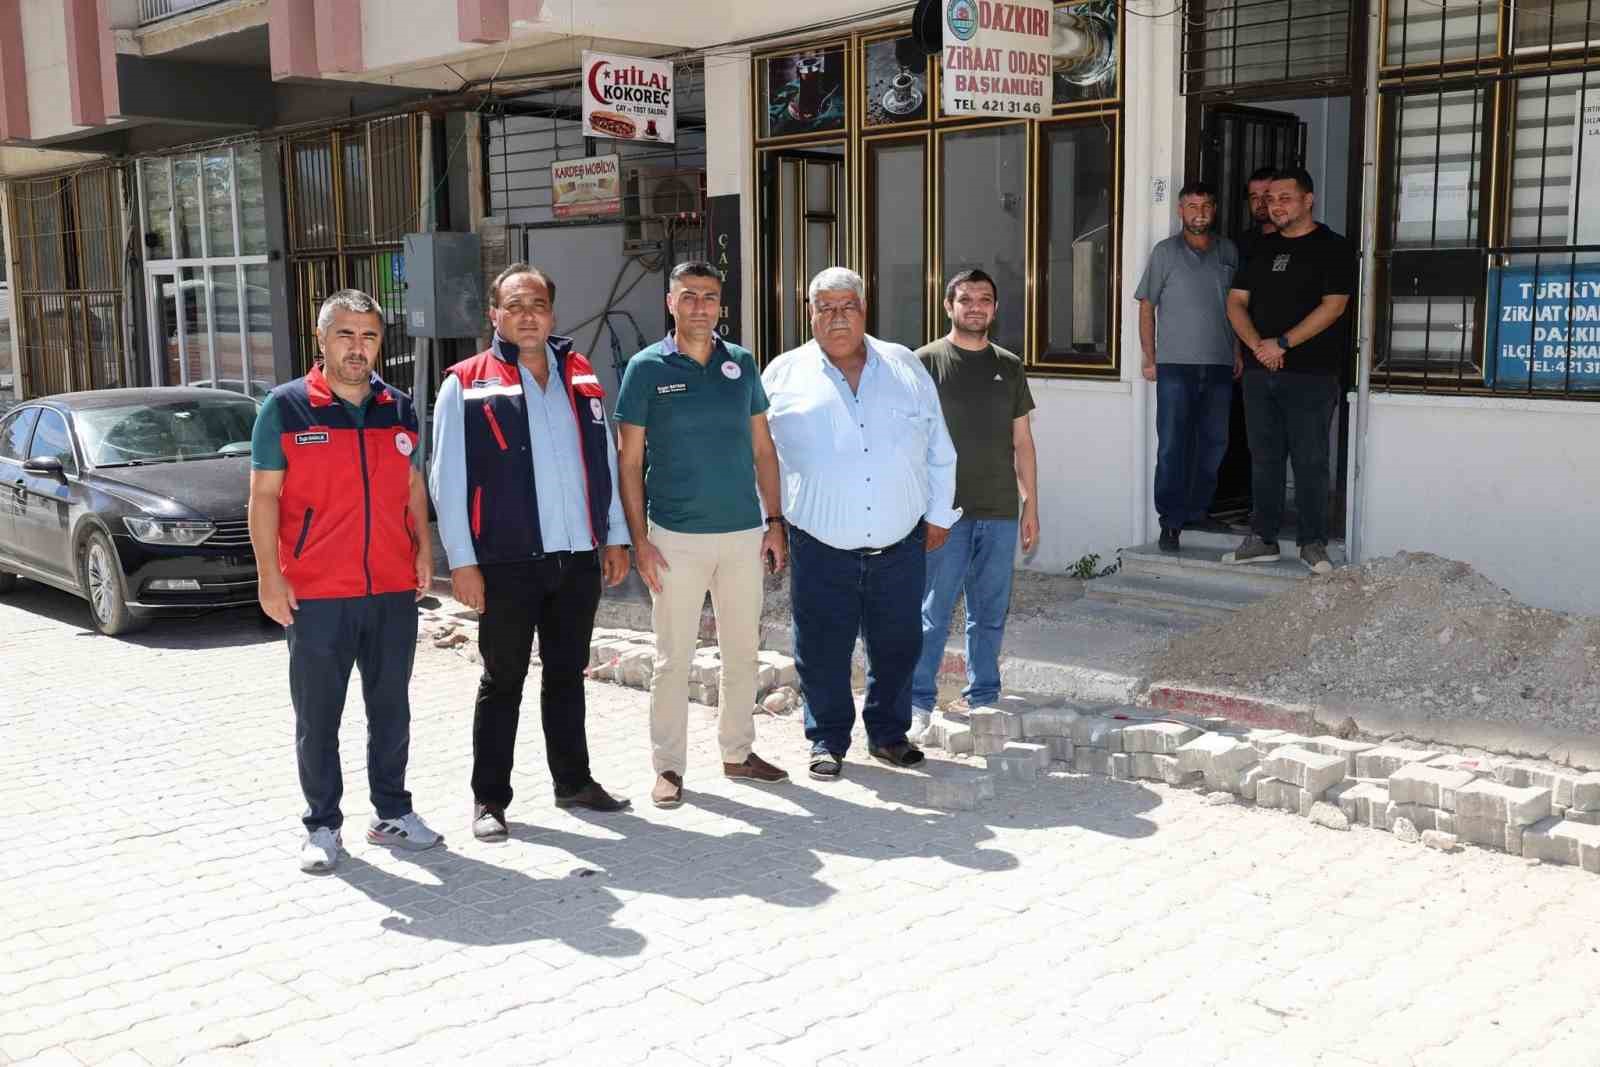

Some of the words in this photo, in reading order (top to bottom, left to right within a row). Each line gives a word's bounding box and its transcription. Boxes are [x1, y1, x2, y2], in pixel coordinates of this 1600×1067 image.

[979, 1, 1050, 37] DAZKIRI
[945, 45, 1003, 72] ZİRAAT
[1008, 50, 1051, 77] ODASI
[613, 65, 671, 92] HİLAL
[955, 74, 1044, 97] BAŞKANLIĞI
[603, 85, 670, 108] KOKOREÇ
[954, 99, 977, 110] TEL
[585, 159, 616, 176] MOBİLYA
[1502, 305, 1562, 322] ZİRAAT
